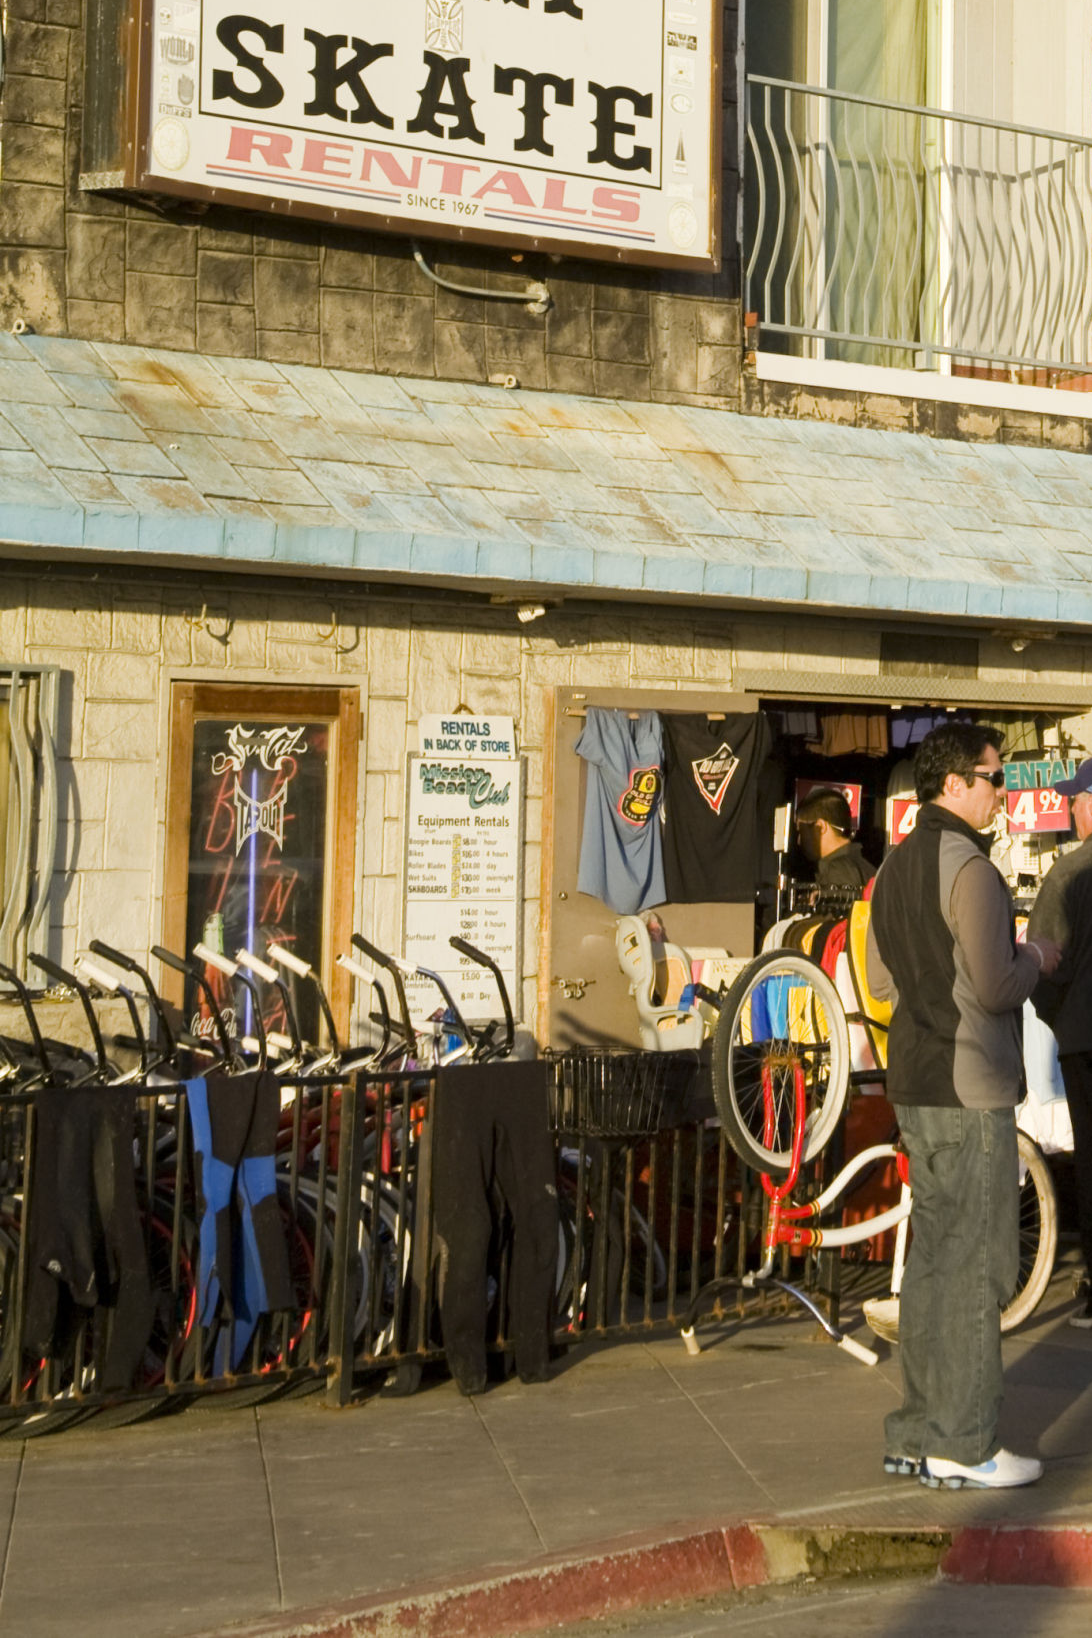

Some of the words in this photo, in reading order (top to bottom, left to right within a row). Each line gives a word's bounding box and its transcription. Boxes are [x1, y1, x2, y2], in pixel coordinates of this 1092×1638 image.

[211, 13, 655, 175] SKATE
[224, 124, 643, 223] RENTALS
[406, 192, 448, 214] SINCE
[451, 197, 480, 218] 1967
[441, 721, 491, 736] RENTALS
[424, 738, 433, 751] IN
[436, 739, 462, 751] BACK
[464, 739, 477, 752] OF
[480, 740, 511, 753] STORE
[420, 762, 486, 781] Mission
[468, 772, 512, 810] Club
[417, 815, 470, 829] Equipment
[474, 815, 510, 828] Rentals
[461, 972, 481, 981] 15.00
